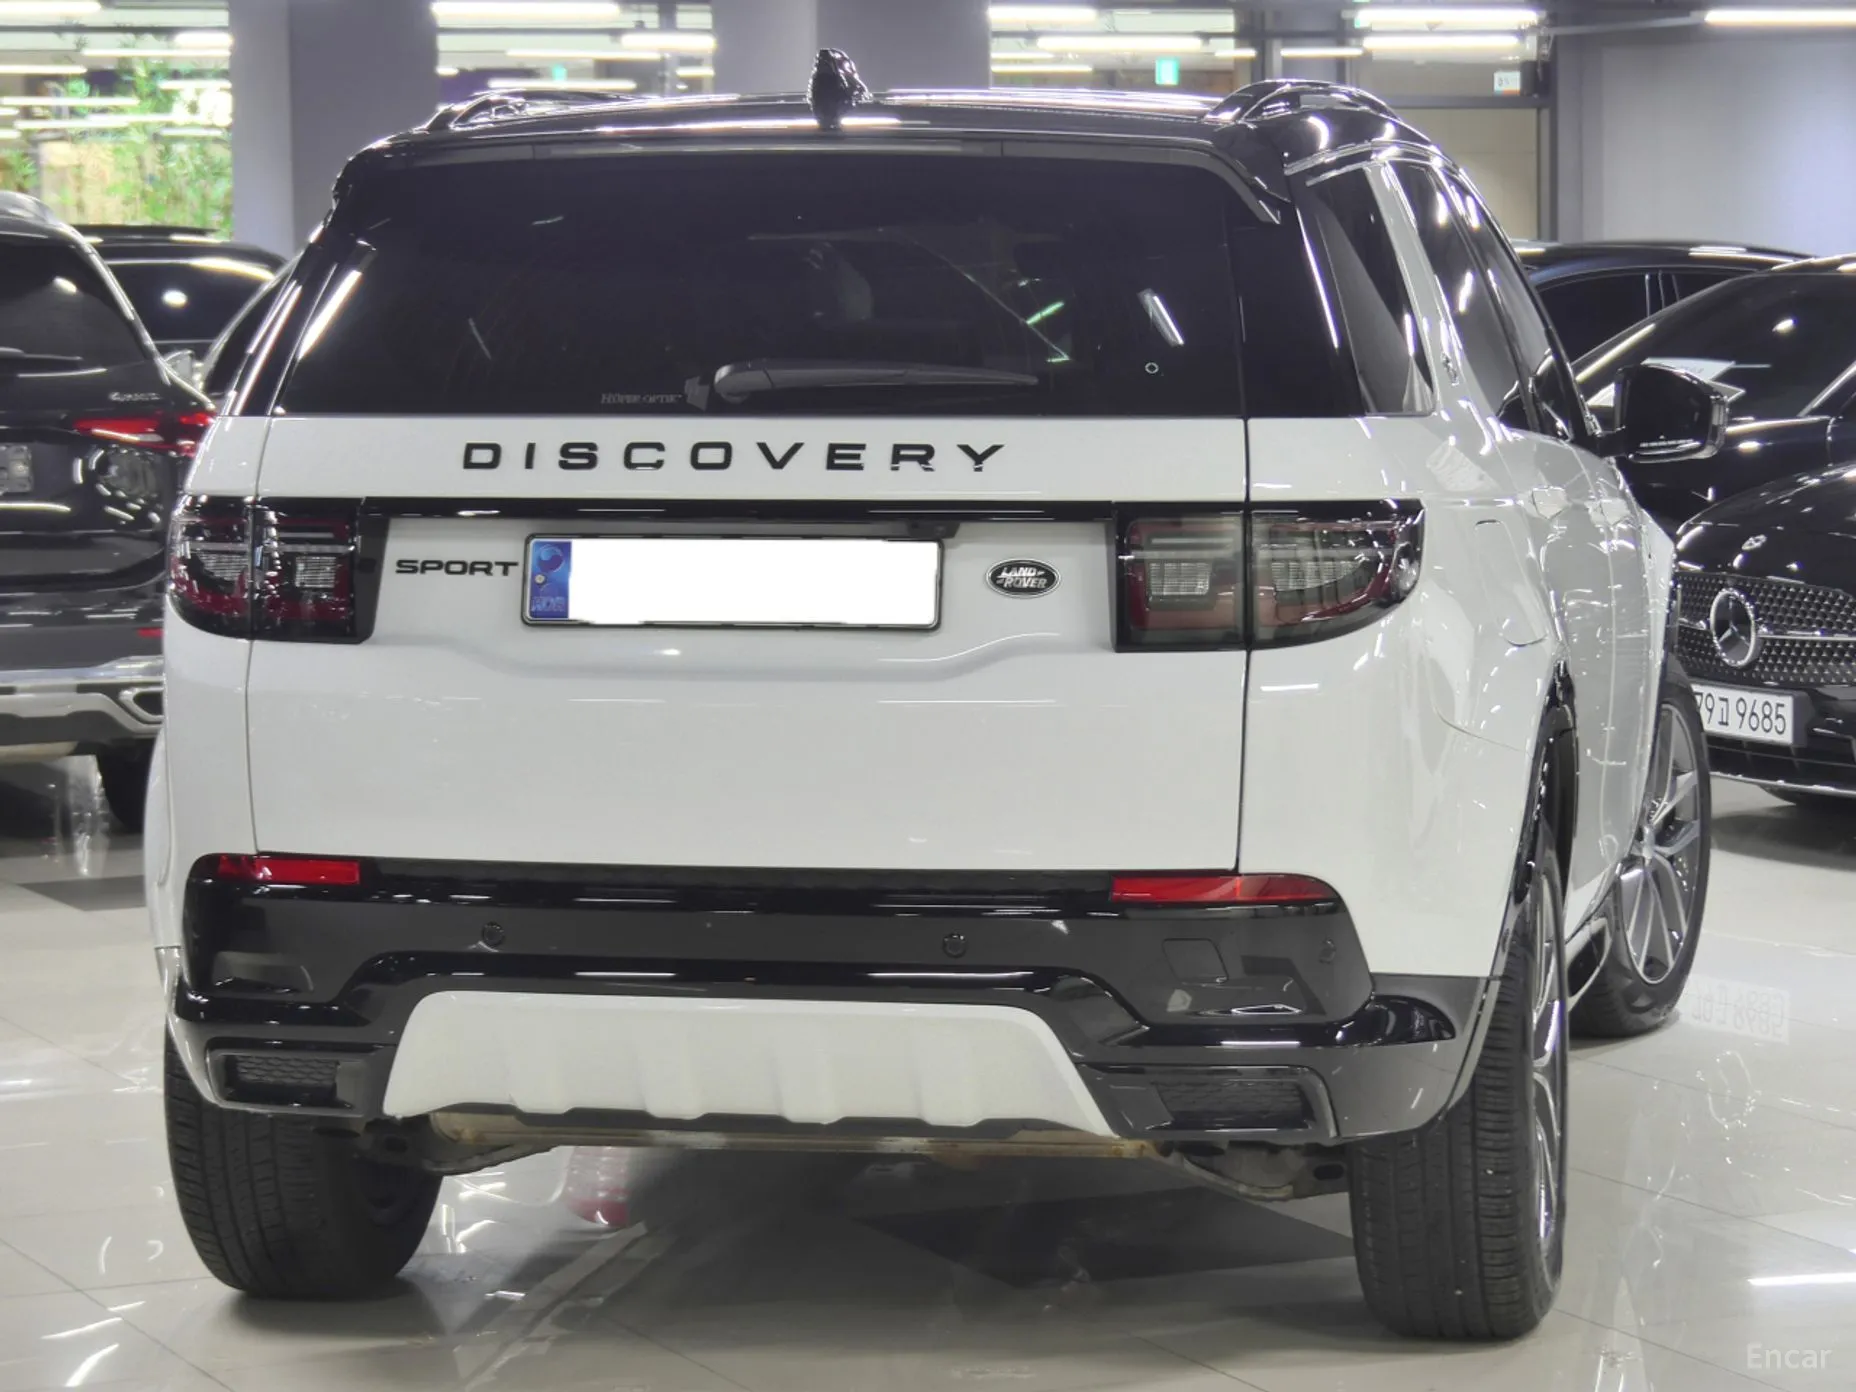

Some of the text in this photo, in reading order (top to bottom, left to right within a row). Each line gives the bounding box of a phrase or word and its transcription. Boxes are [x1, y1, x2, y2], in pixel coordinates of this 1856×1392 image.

[463, 442, 1004, 471] DISCOVERY
[396, 560, 519, 576] SPORT
[1001, 567, 1038, 577] LAND
[1003, 578, 1047, 588] ROVER
[1736, 697, 1786, 735] 9685
